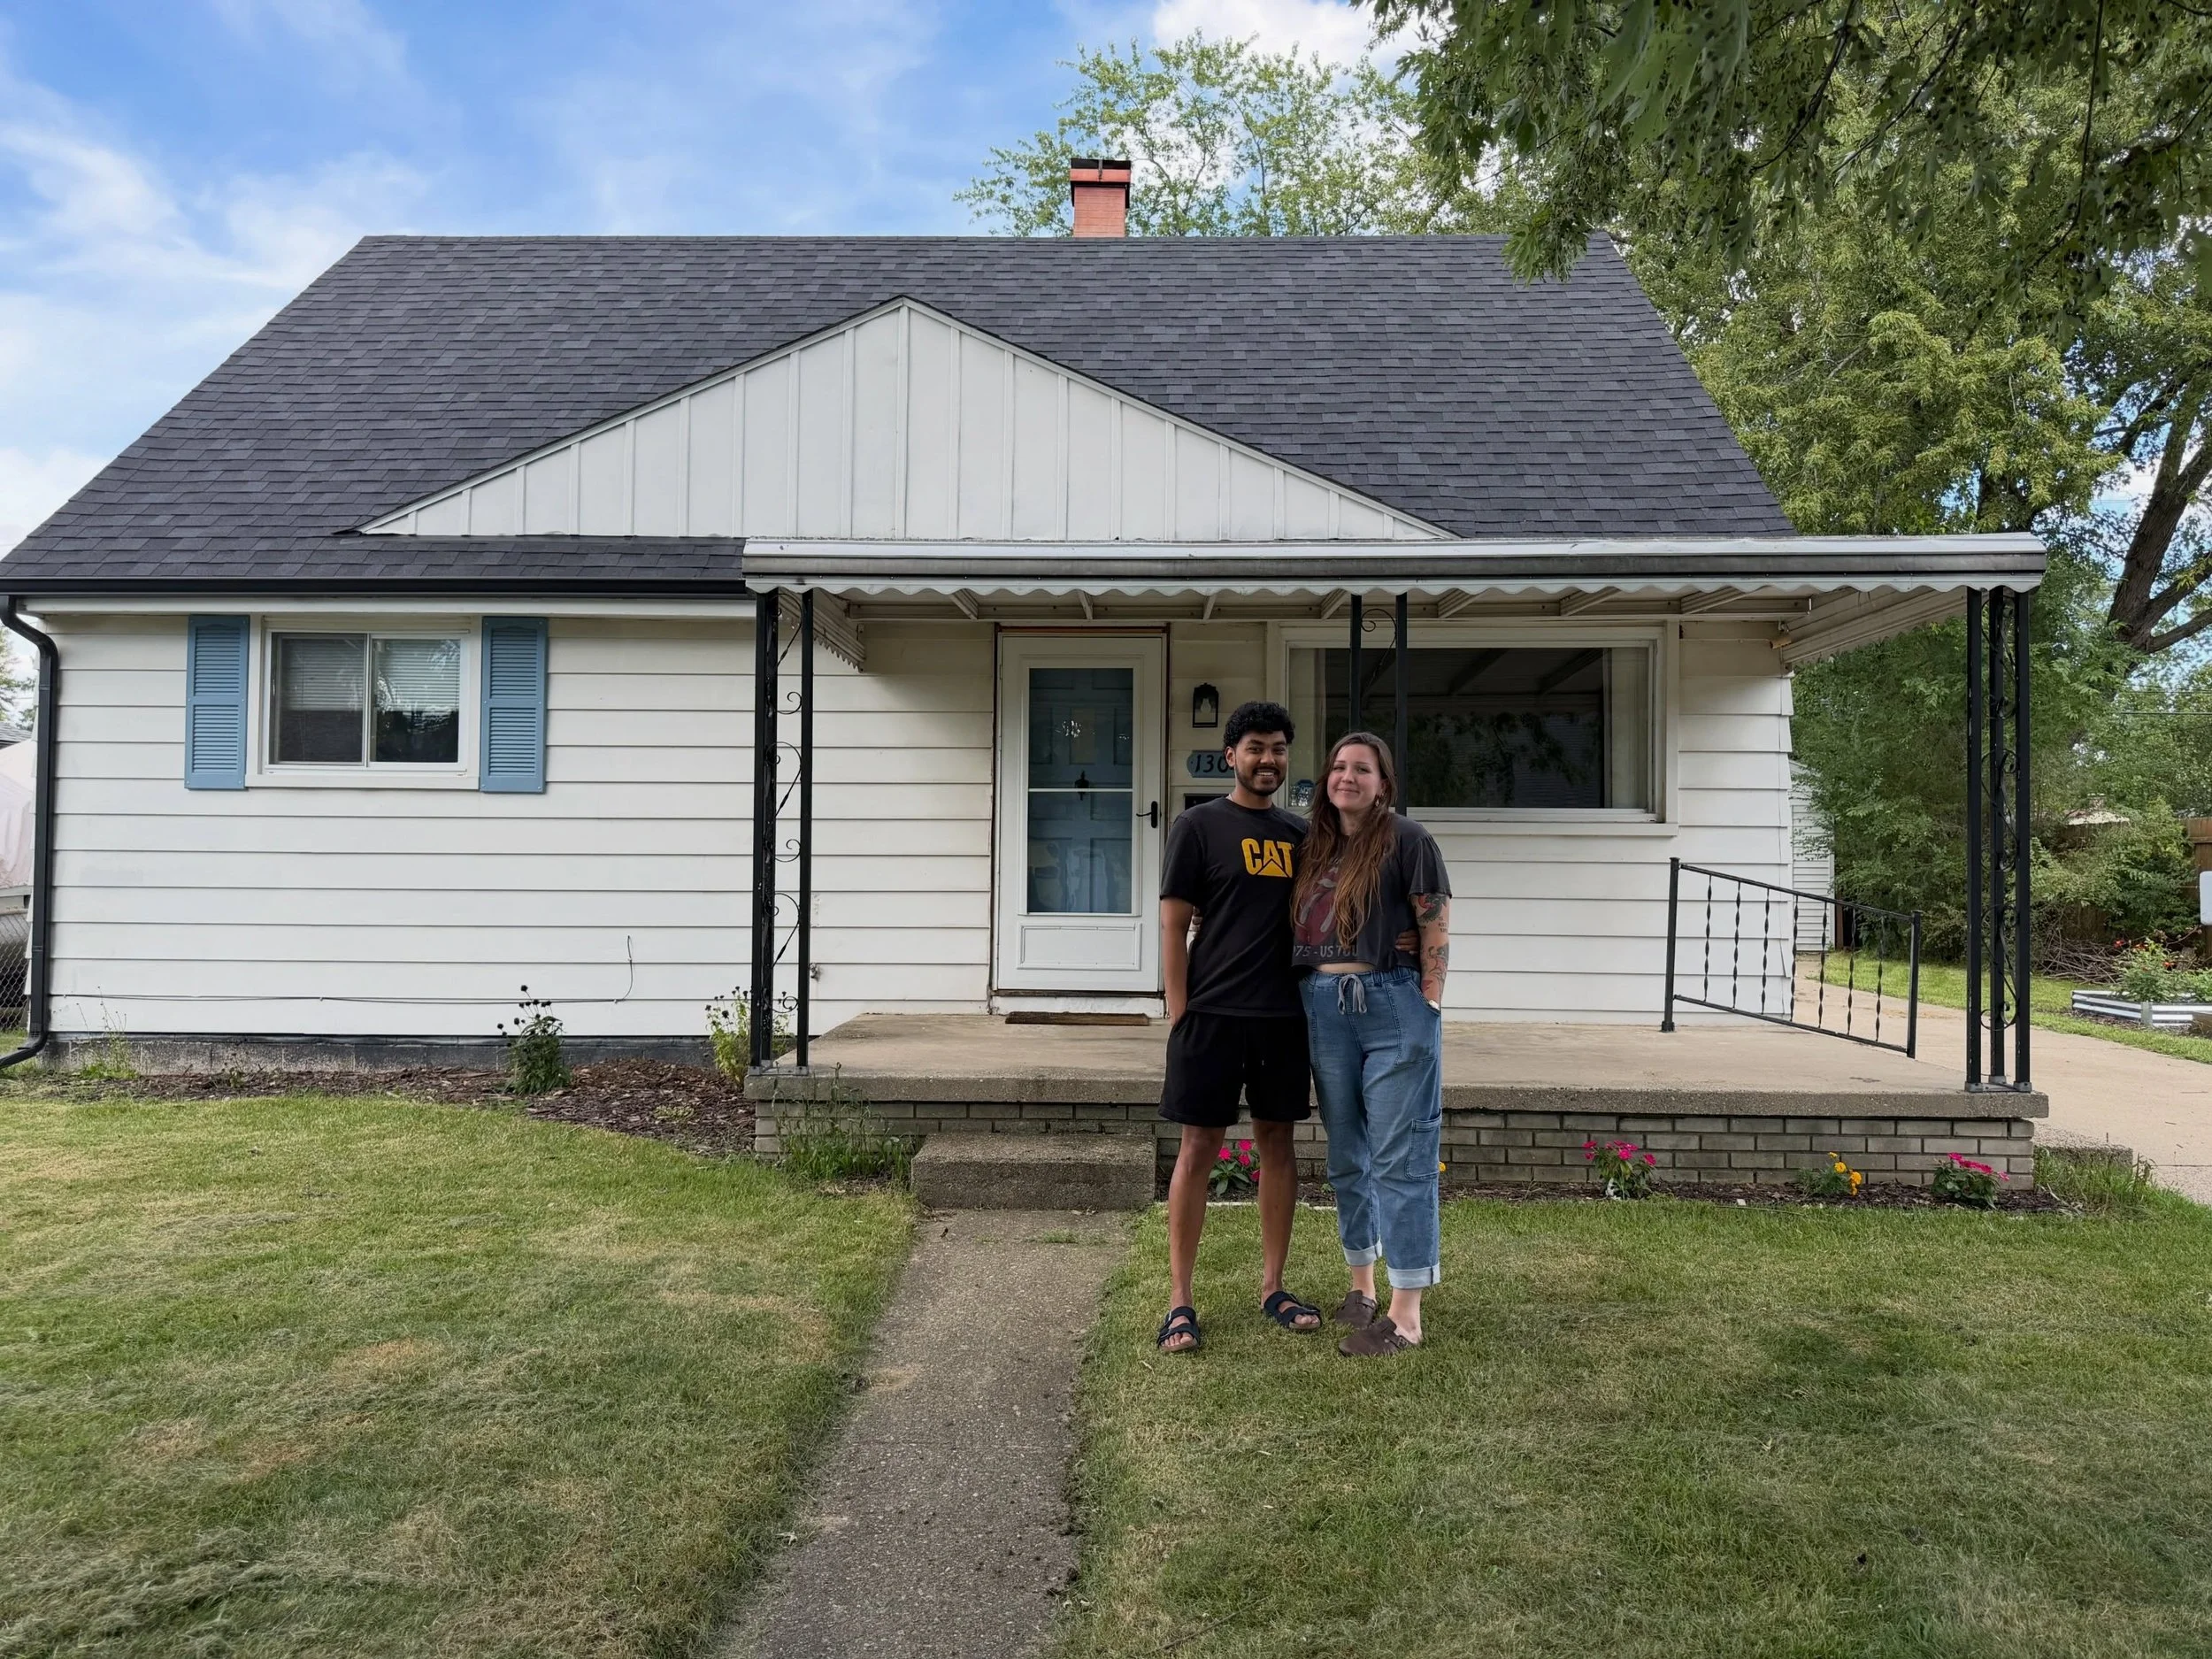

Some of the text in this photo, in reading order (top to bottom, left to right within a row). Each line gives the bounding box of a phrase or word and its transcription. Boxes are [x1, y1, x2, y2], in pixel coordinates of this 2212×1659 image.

[1194, 754, 1233, 773] 130
[1240, 837, 1294, 879] CAT
[1320, 945, 1334, 958] US
